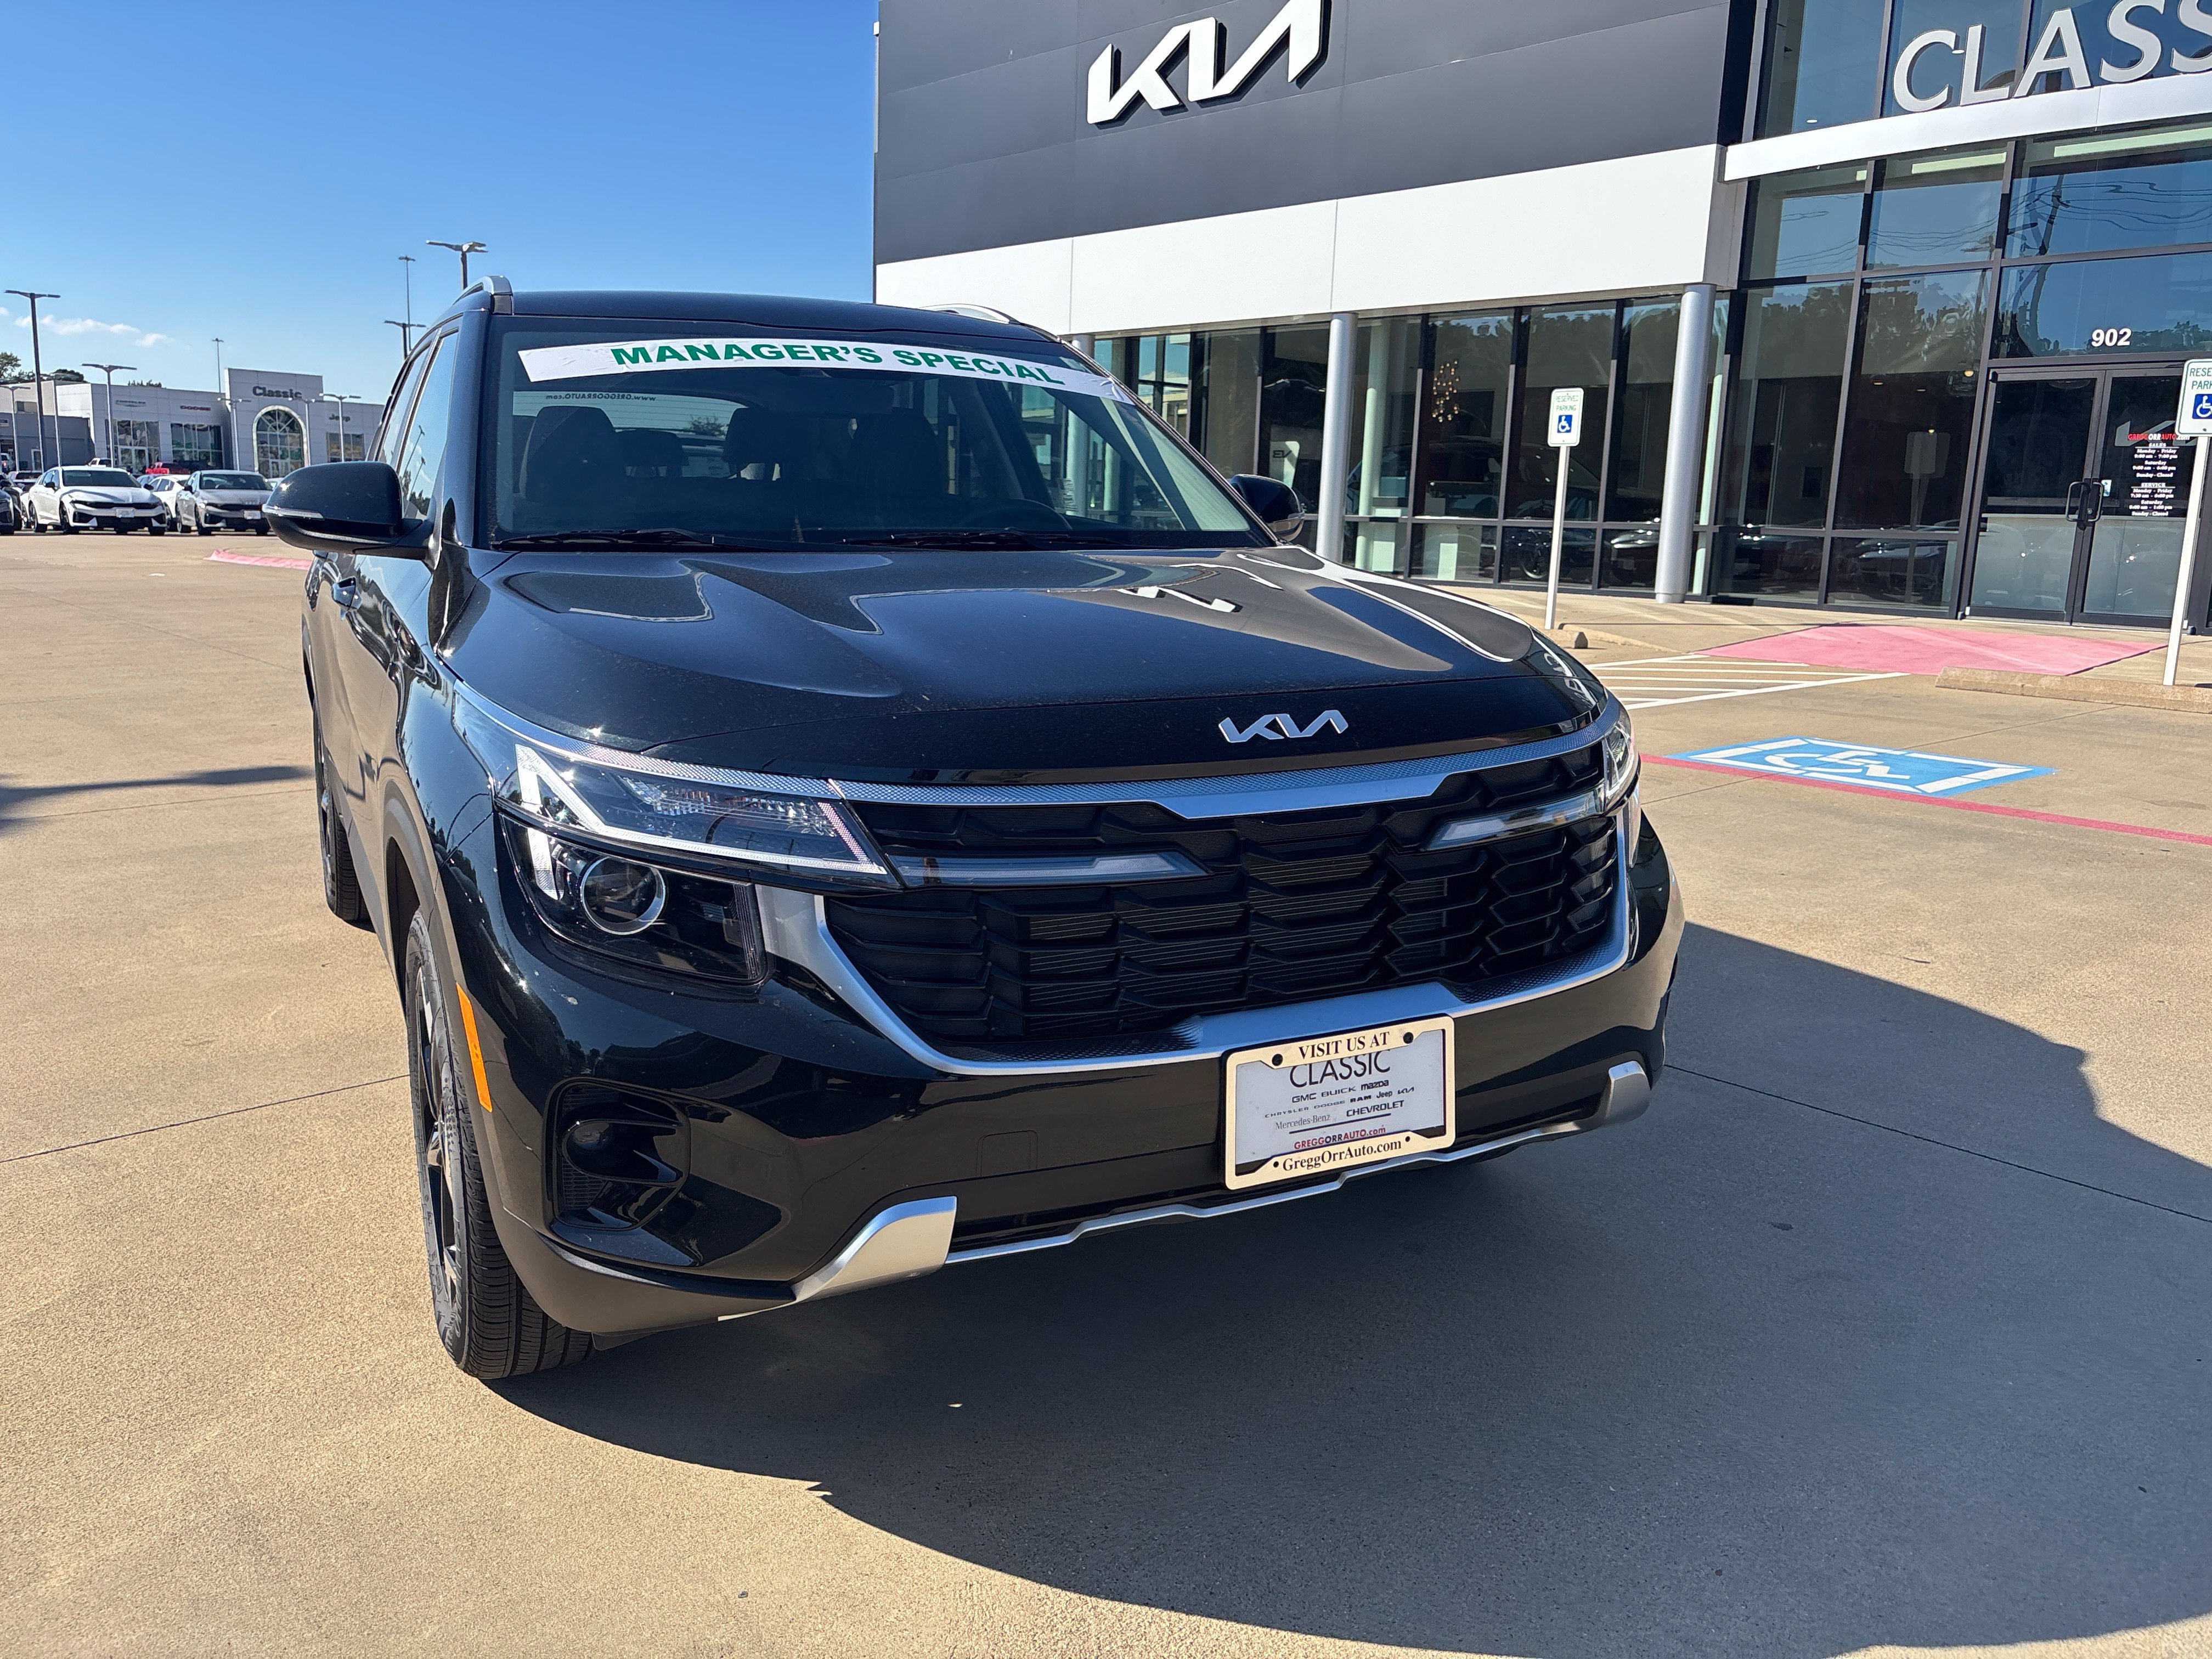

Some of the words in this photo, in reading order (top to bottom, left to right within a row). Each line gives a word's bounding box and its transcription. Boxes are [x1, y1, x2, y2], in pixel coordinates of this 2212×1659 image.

[1087, 0, 1322, 125] KIA
[2091, 328, 2132, 347] 902
[610, 343, 883, 365] MANAGER'S
[893, 350, 1065, 385] SPECIAL
[252, 386, 302, 399] Classic
[1218, 709, 1349, 743] KIA
[1298, 1040, 1342, 1059] VISIT
[1346, 1036, 1365, 1051] US
[1370, 1031, 1390, 1047] AT
[1290, 1049, 1391, 1088] CLASSIC
[1265, 1107, 1309, 1118] CHRYSLER
[1314, 1100, 1345, 1109] DODGE
[1350, 1094, 1372, 1103] RAM
[1376, 1090, 1393, 1099] Jeep
[1397, 1086, 1414, 1094] KIA
[1291, 1092, 1317, 1103] GMC
[1321, 1086, 1356, 1097] BUICK
[1275, 1114, 1331, 1130] Mercedes-Benz
[1346, 1099, 1404, 1117] CHEVROLET
[1294, 1127, 1386, 1149] GREGGORRAUTO.com
[1283, 1140, 1402, 1172] GreggOrrAuto.com
